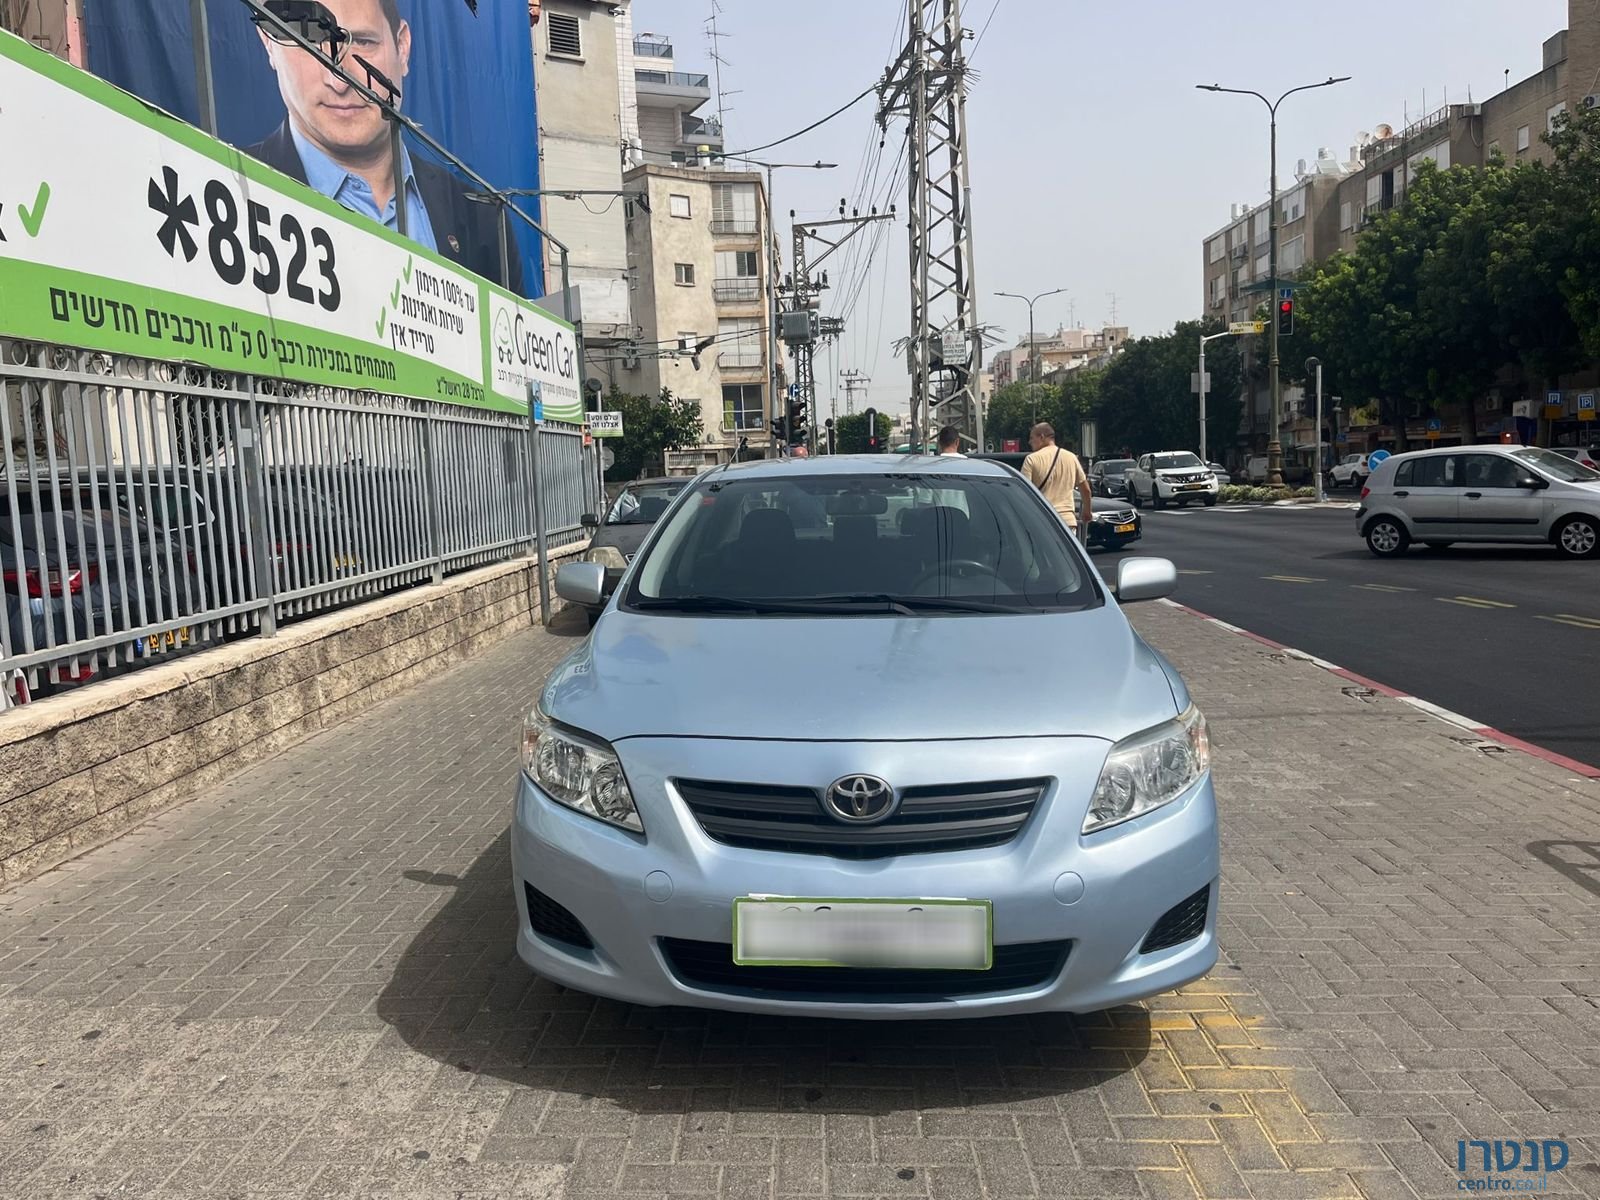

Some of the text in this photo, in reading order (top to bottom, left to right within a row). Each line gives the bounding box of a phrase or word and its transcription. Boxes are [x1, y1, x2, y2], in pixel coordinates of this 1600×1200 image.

[415, 269, 475, 313] עד 100% מימון
[49, 286, 140, 335] חדשים
[401, 294, 464, 335] שירות ואמינות
[145, 308, 213, 348] ורכבים
[257, 329, 268, 360] 0
[390, 322, 435, 355] טרייד אין
[271, 337, 304, 364] רכבי
[306, 344, 353, 374] במכירת
[514, 313, 574, 380] Green Car
[354, 354, 396, 381] מתמחים
[462, 382, 471, 399] 28
